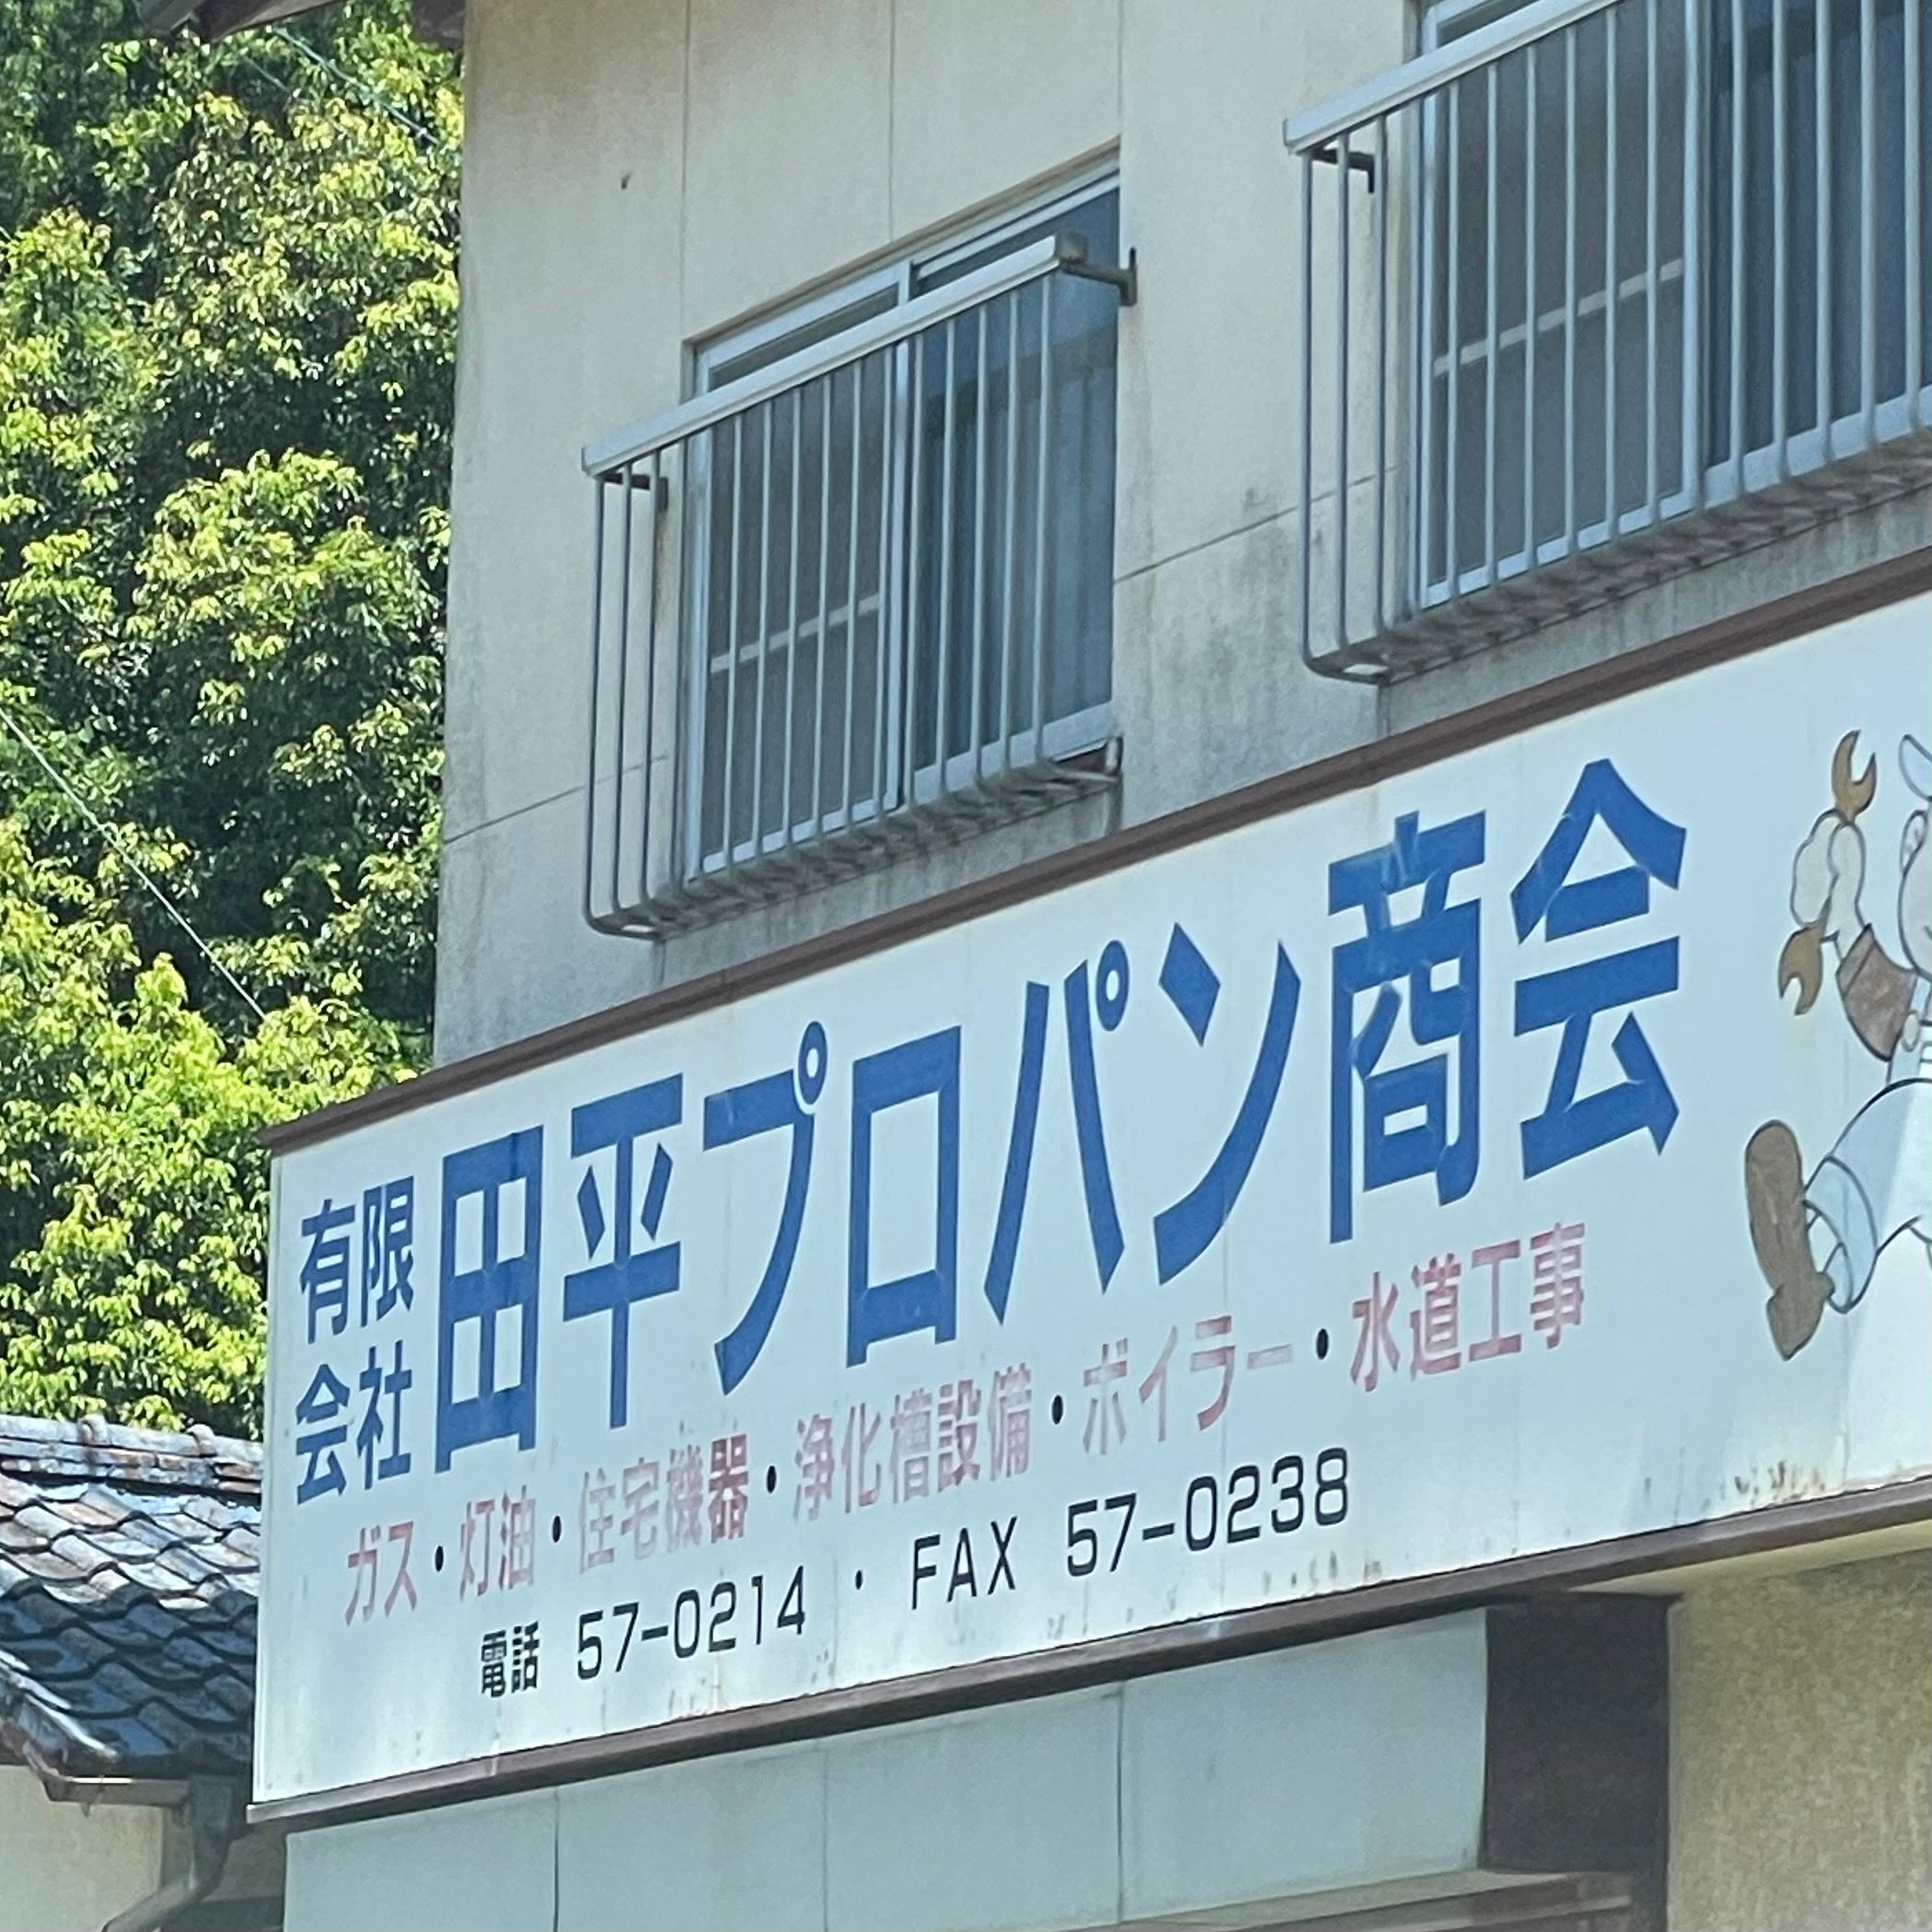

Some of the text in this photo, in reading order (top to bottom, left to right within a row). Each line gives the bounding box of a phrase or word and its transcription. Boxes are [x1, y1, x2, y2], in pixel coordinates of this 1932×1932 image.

[435, 758, 1687, 1473] 田平プロパン商会
[299, 1175, 413, 1344] 有限
[295, 1339, 413, 1504] 会社
[480, 1620, 540, 1697] 電話
[577, 1566, 805, 1680] 57-0214
[911, 1516, 1018, 1610] FAX
[1067, 1447, 1348, 1578] 57-0238
